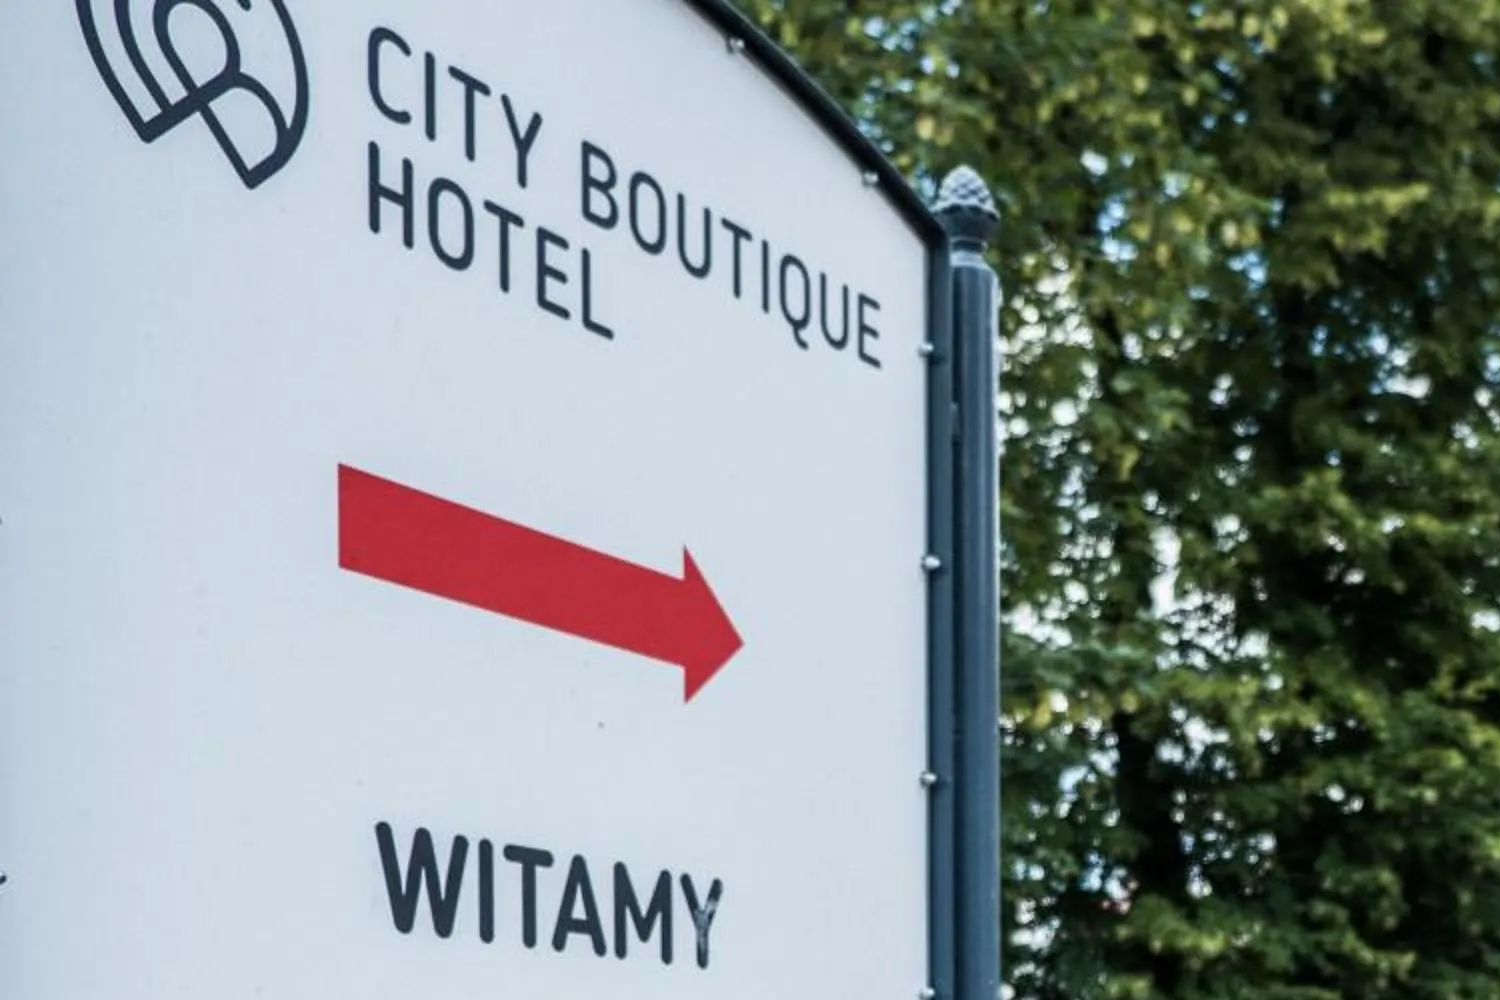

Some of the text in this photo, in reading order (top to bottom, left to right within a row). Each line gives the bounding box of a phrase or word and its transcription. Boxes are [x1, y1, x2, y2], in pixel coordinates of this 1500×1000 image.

[367, 26, 882, 369] CITY BOUTIQUE
[367, 140, 615, 341] HOTEL
[374, 820, 723, 970] WITAMY
